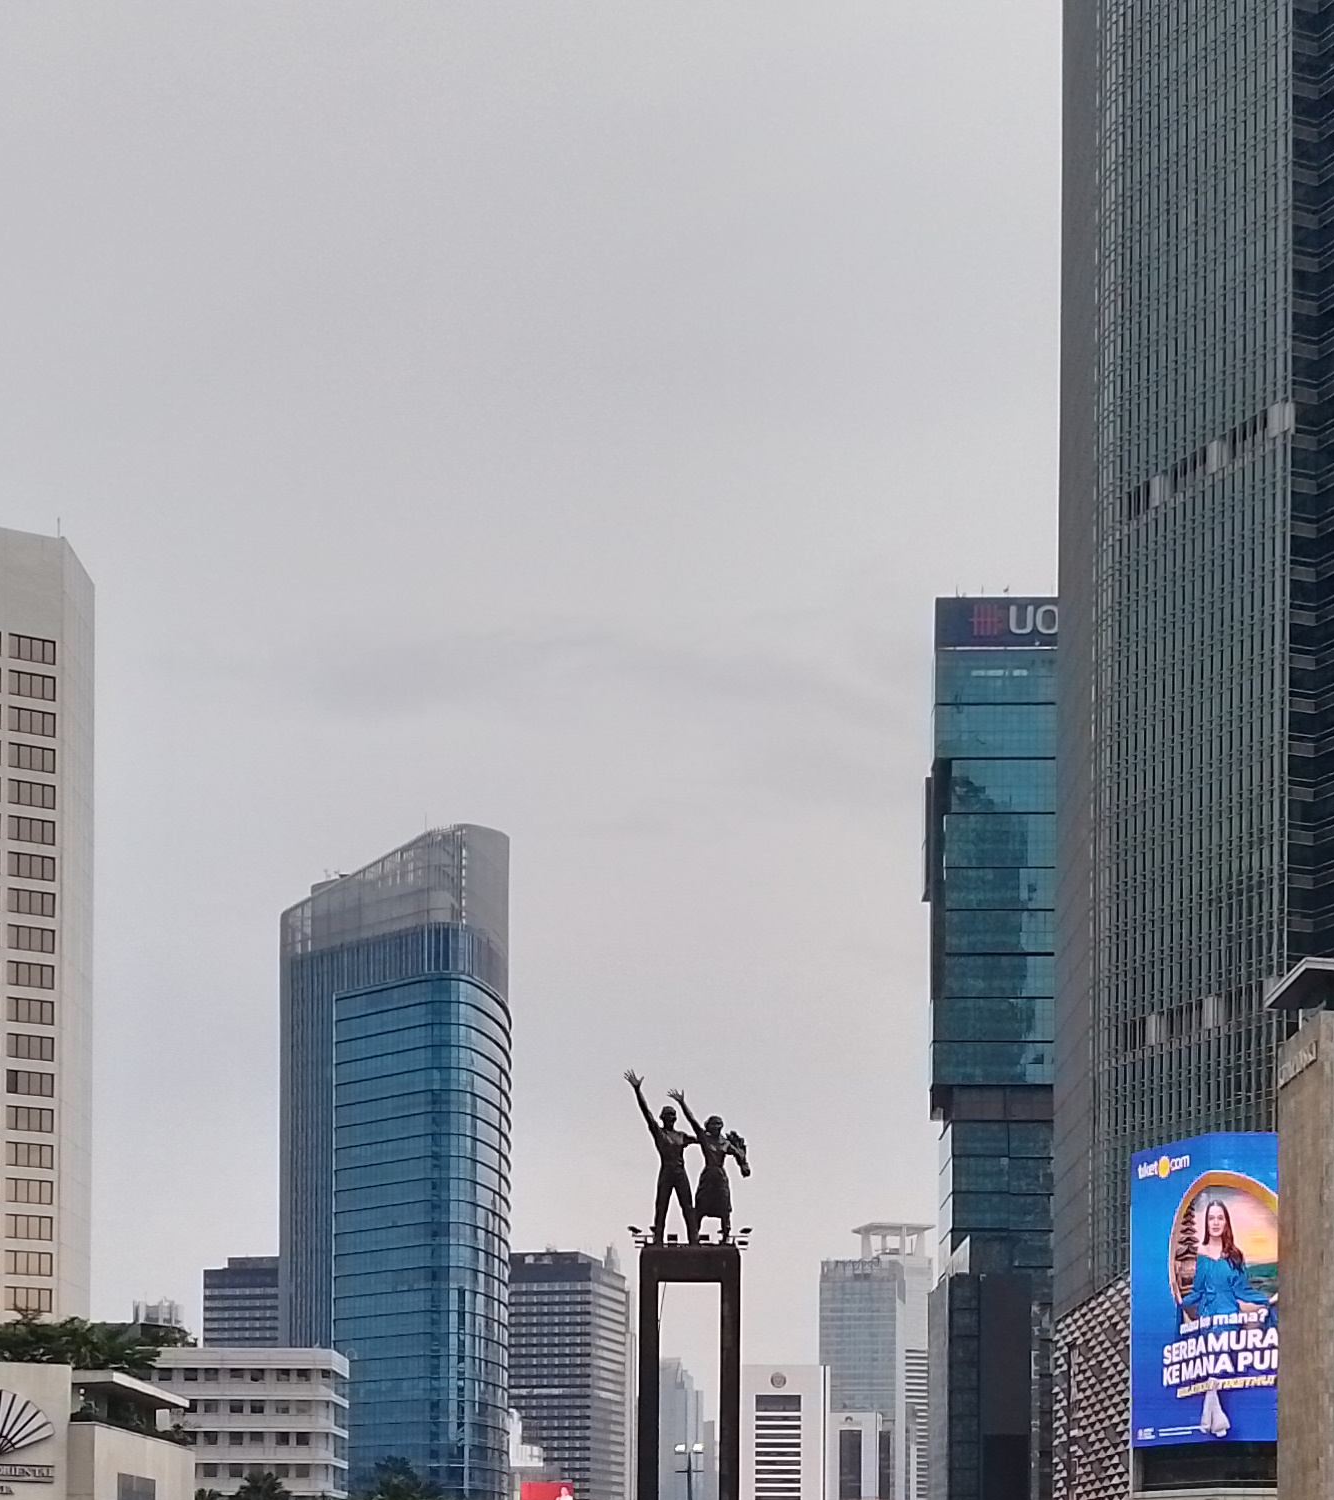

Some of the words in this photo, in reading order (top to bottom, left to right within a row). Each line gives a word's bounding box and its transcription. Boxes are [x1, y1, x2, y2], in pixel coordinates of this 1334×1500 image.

[1009, 604, 1058, 634] UO
[1213, 1308, 1268, 1325] mana?
[1163, 1363, 1180, 1387] KE
[1182, 1353, 1234, 1381] MANA
